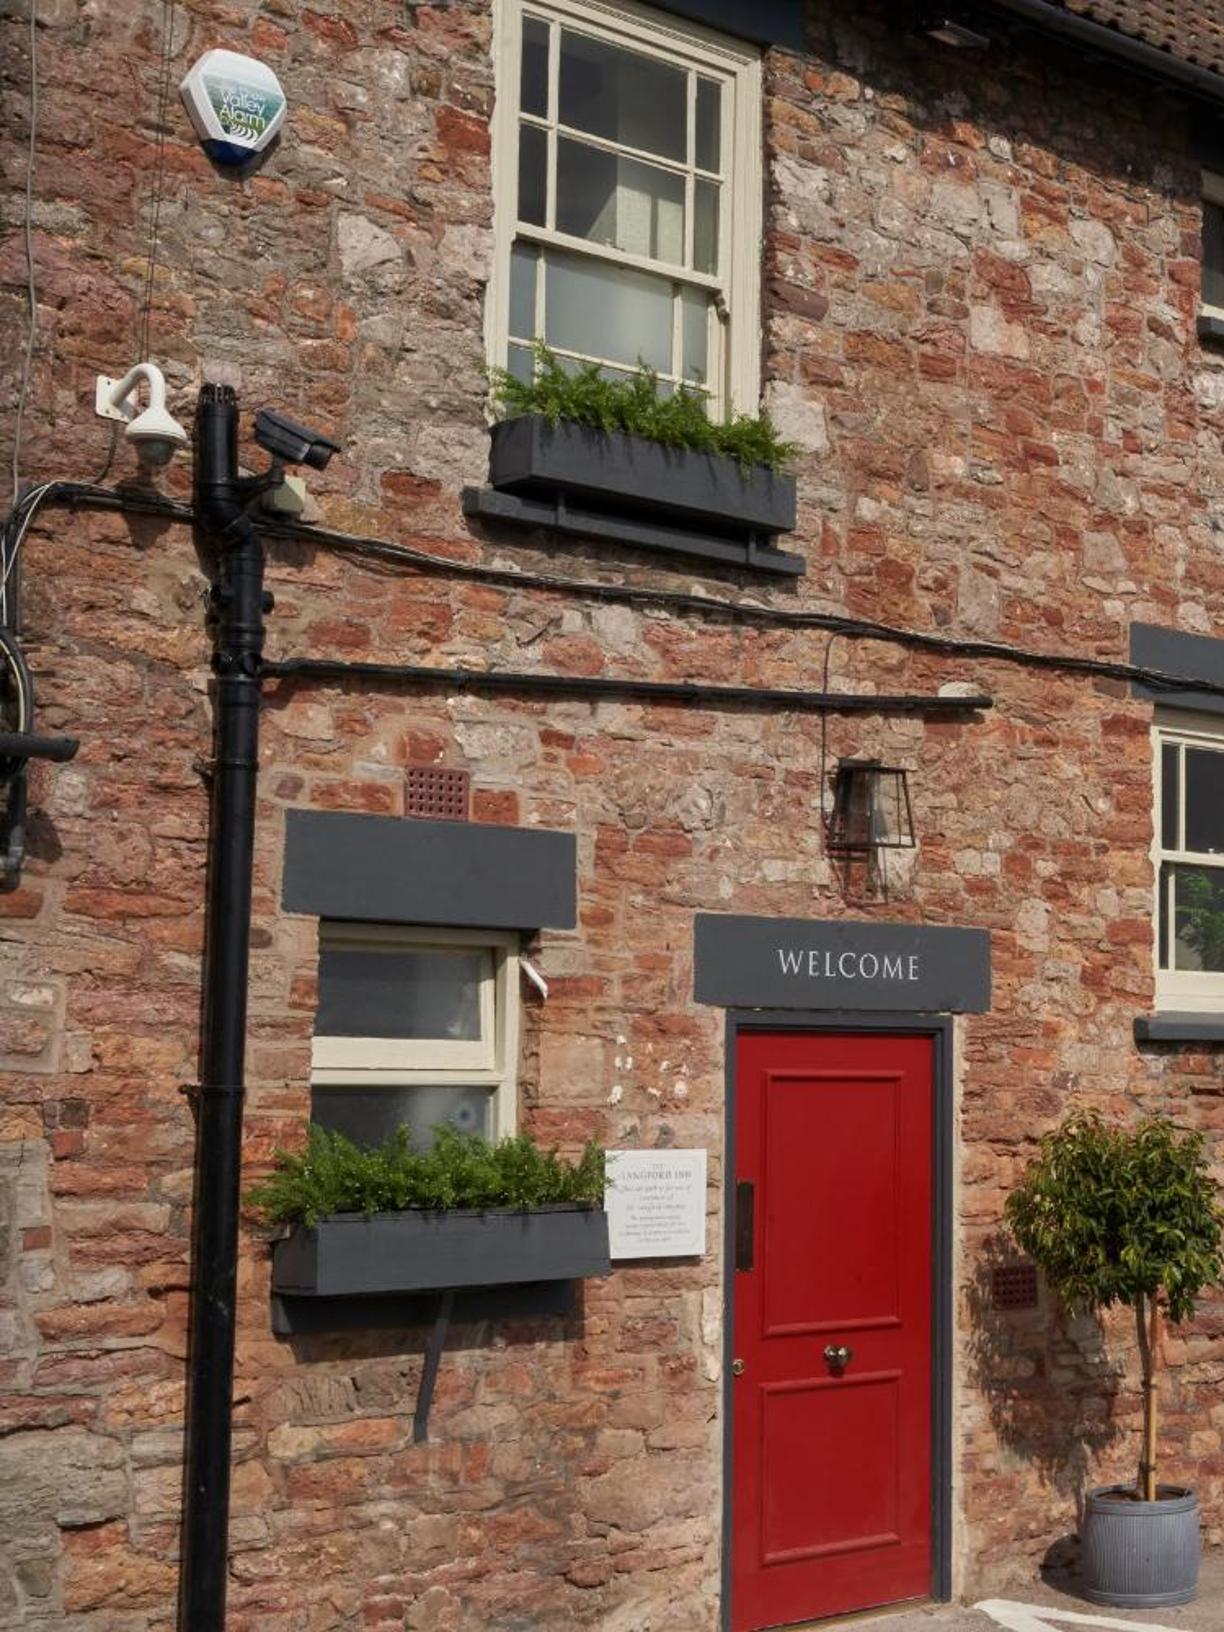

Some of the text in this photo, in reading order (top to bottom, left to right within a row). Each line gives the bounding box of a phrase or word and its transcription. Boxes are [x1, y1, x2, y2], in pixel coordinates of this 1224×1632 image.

[221, 91, 266, 116] Valley
[220, 104, 265, 129] Alarm
[777, 949, 920, 981] WELCOME
